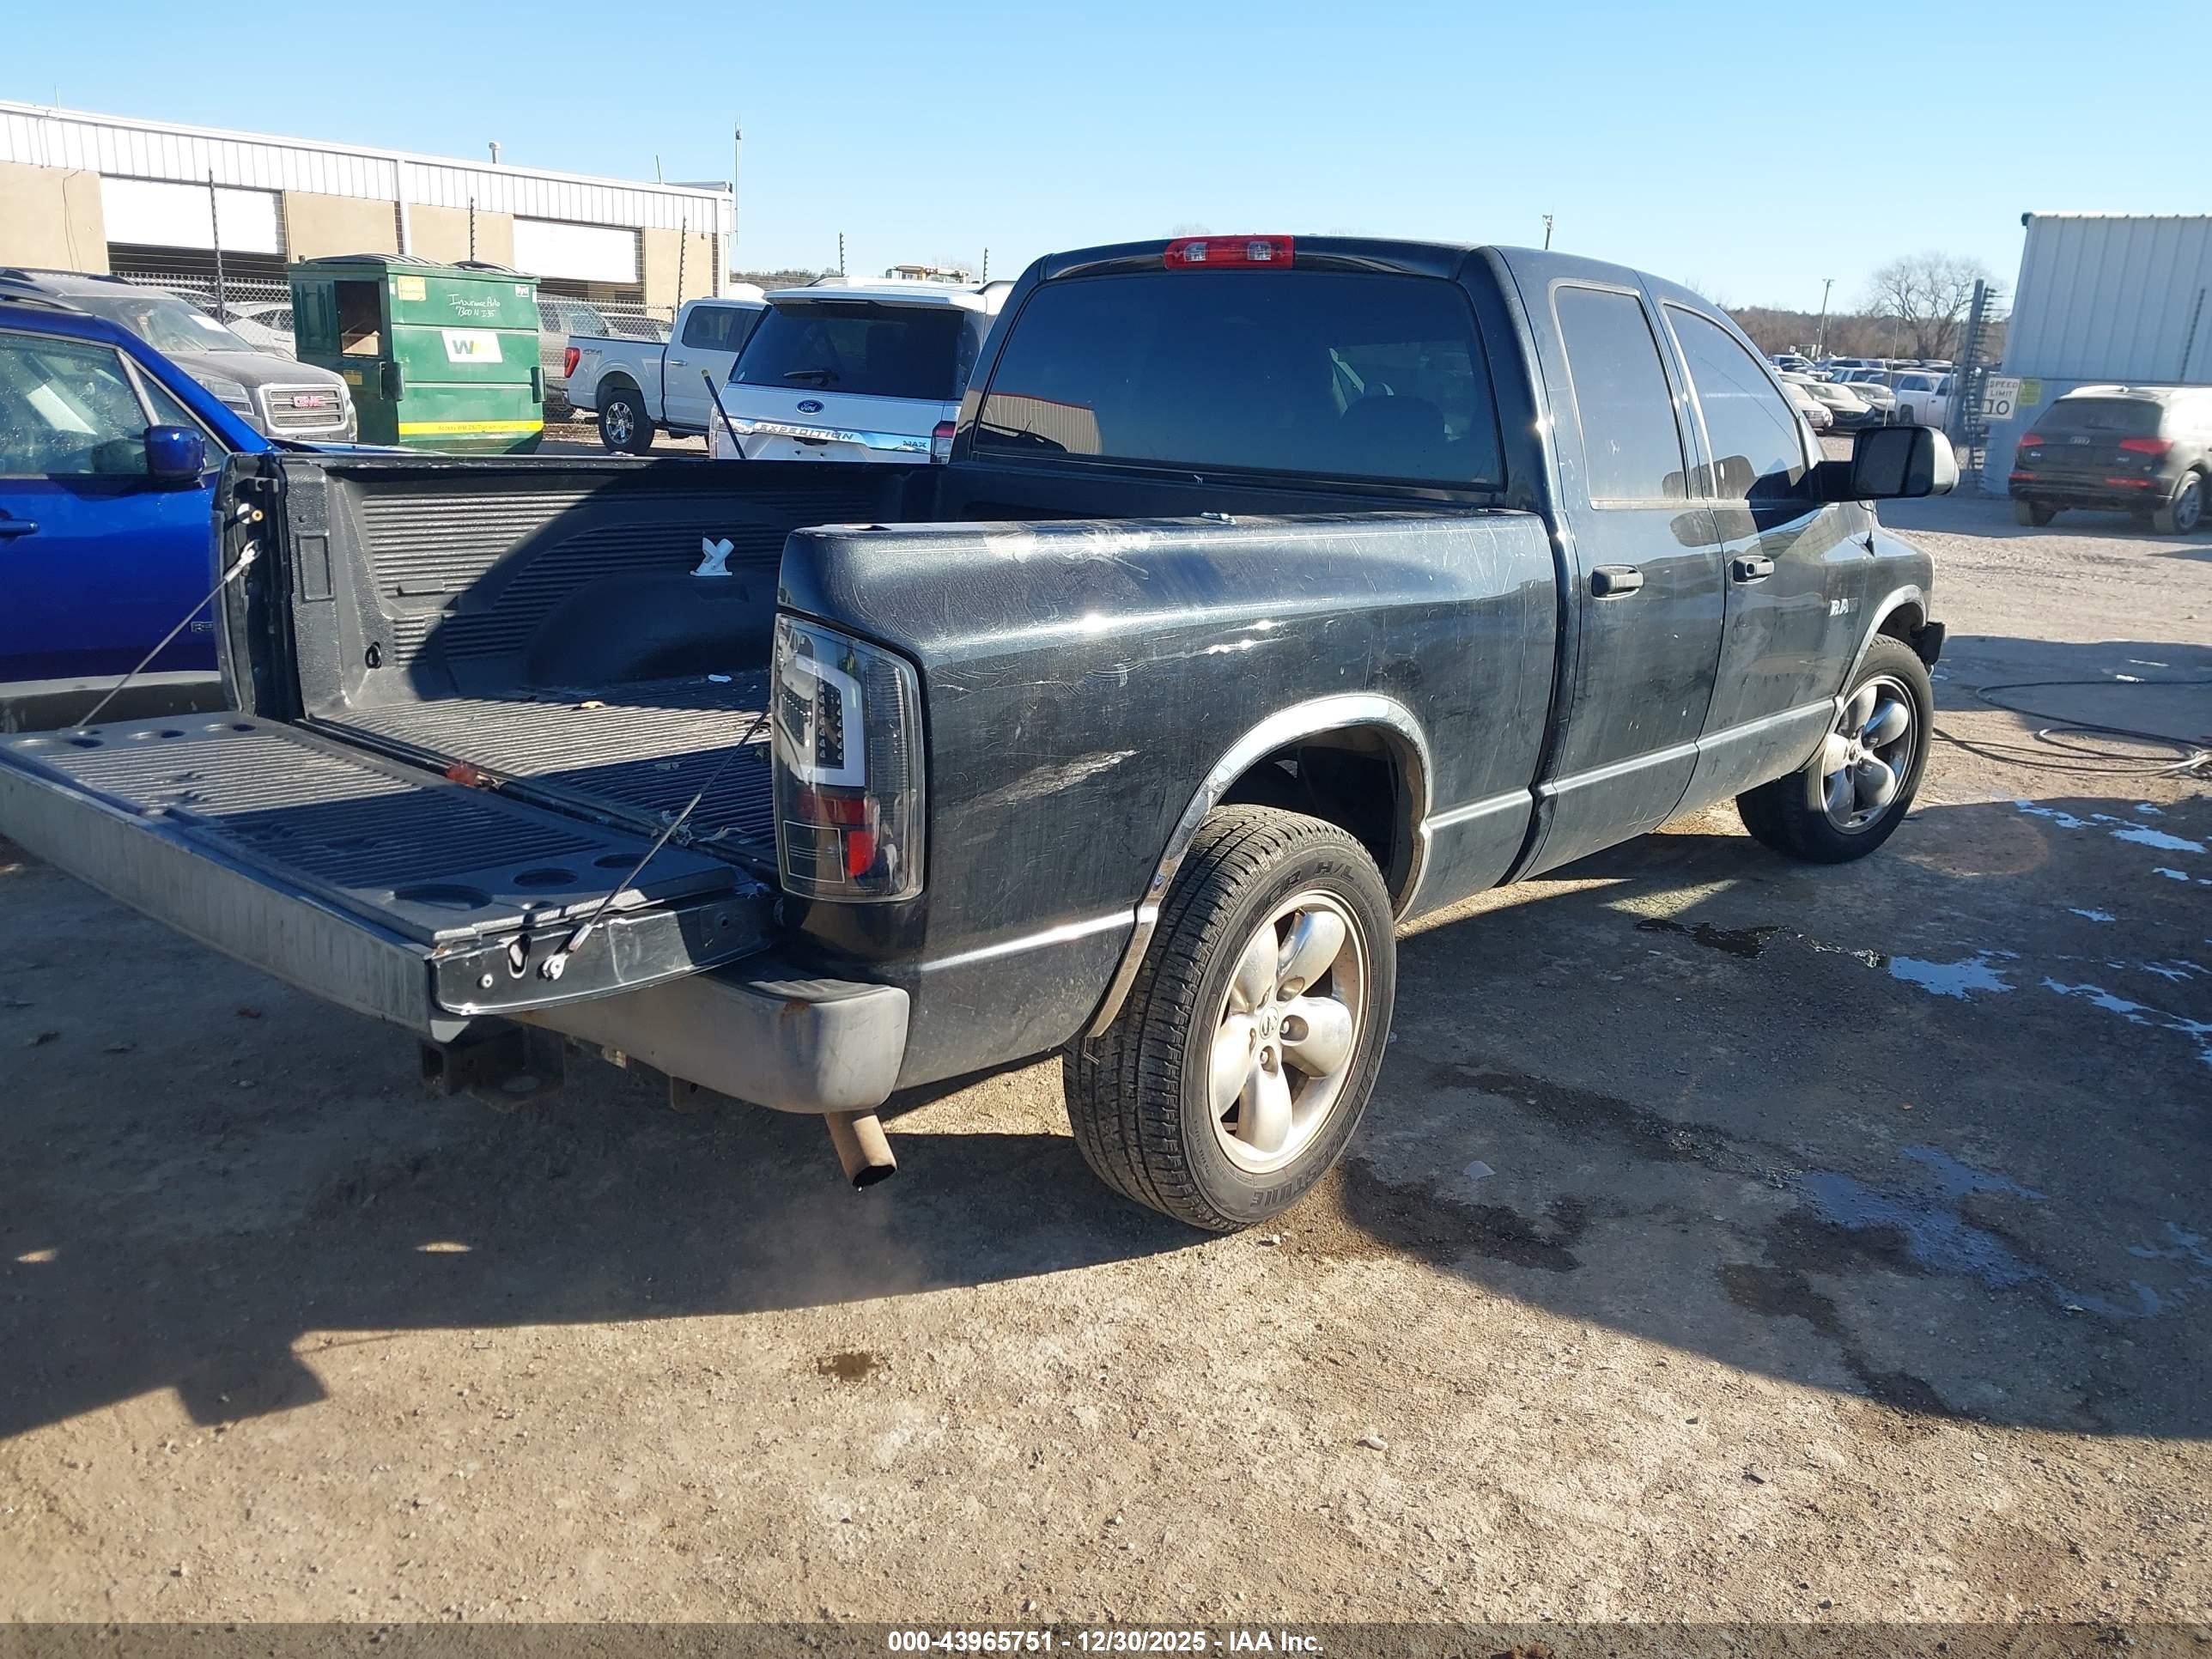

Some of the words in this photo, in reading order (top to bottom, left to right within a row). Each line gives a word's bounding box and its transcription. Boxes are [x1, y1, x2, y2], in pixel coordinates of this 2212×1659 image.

[486, 295, 501, 307] Auto
[455, 306, 472, 317] 7300
[1988, 380, 2019, 389] SPEED
[294, 395, 325, 407] GMC
[799, 400, 818, 413] Ford
[1983, 398, 2010, 416] 10
[758, 423, 854, 441] EXPEDITION
[902, 440, 927, 448] MAX
[1314, 860, 1355, 882] H/L
